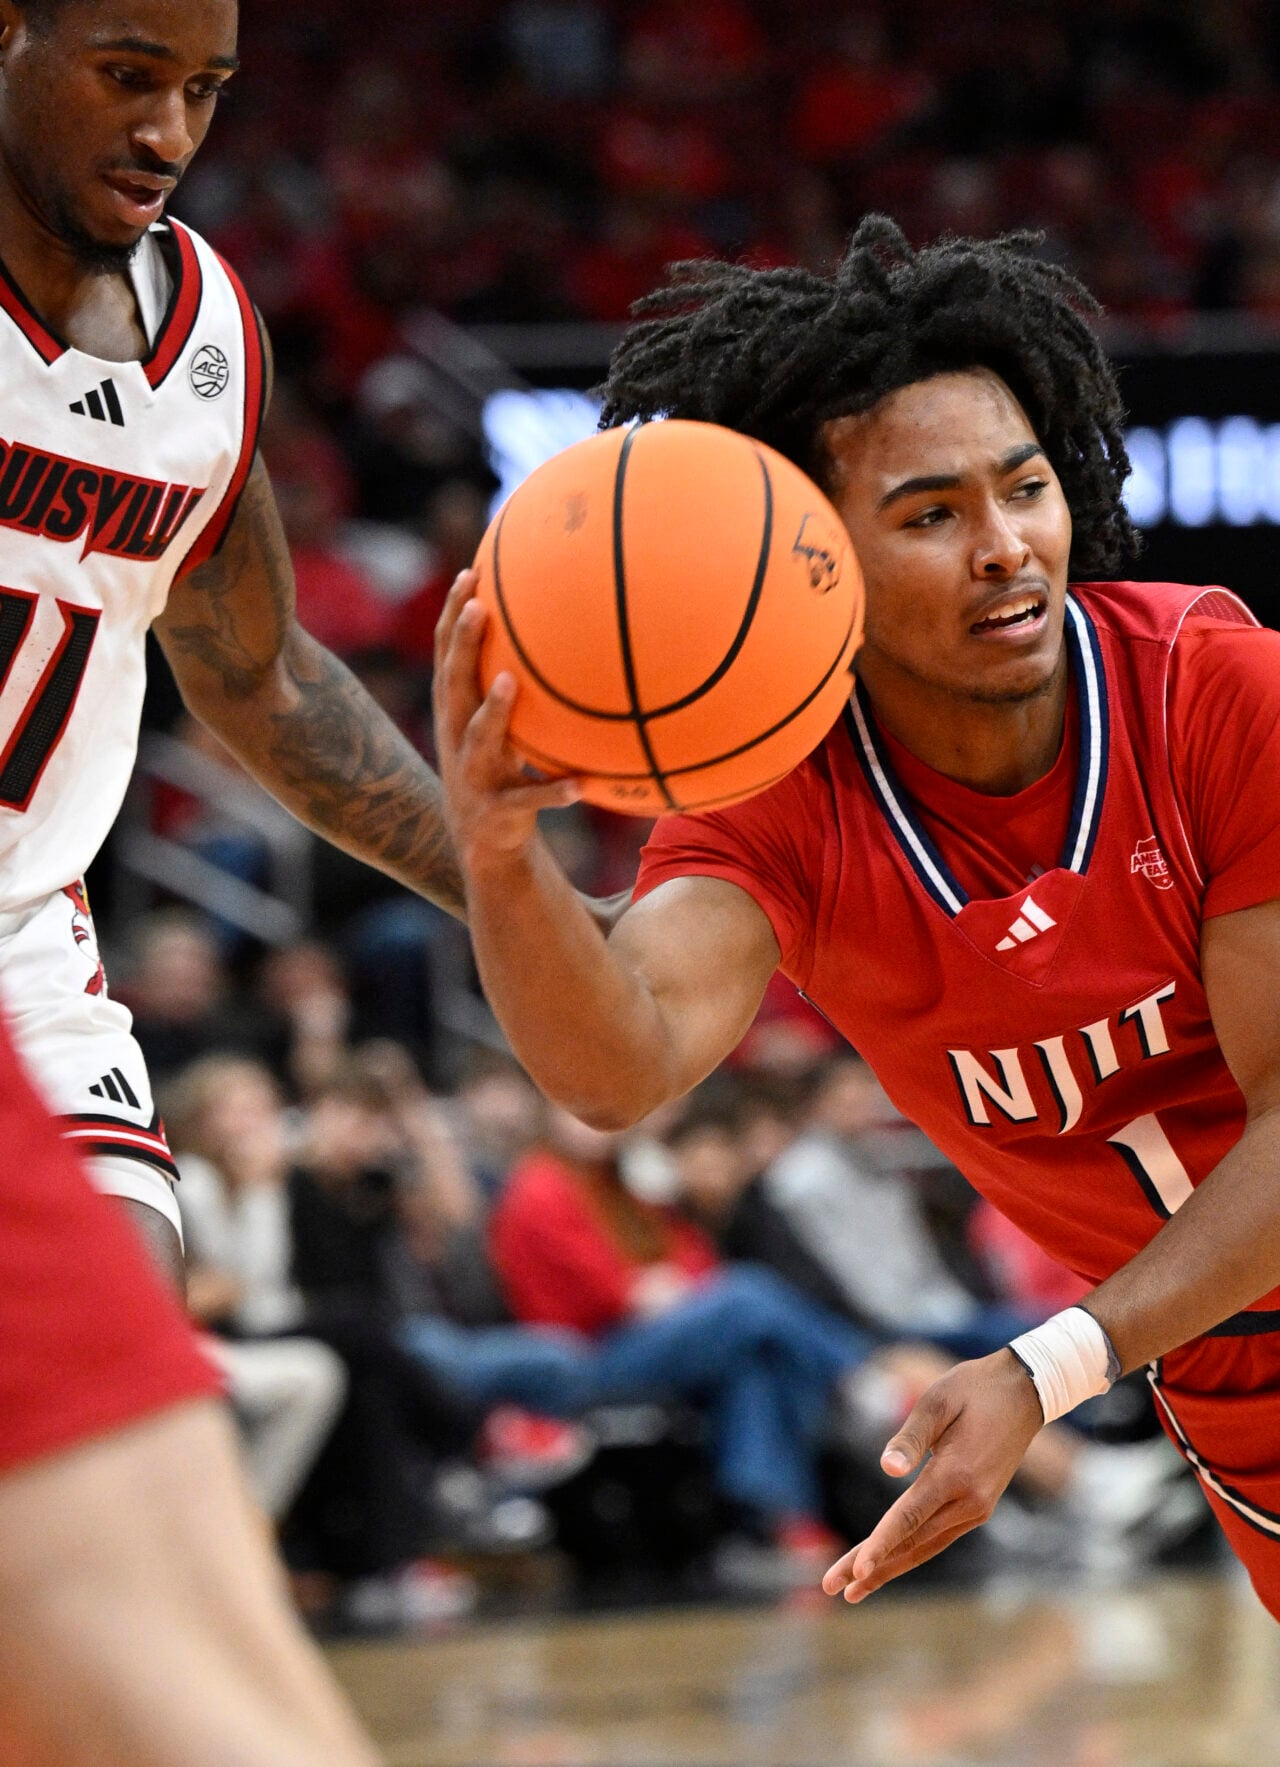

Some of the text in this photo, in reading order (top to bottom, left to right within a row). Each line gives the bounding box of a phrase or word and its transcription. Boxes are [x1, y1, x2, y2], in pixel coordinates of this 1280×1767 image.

[195, 361, 228, 378] ACC
[0, 437, 207, 564] UISVILL
[946, 980, 1177, 1137] NJIT
[1106, 1111, 1196, 1221] 1
